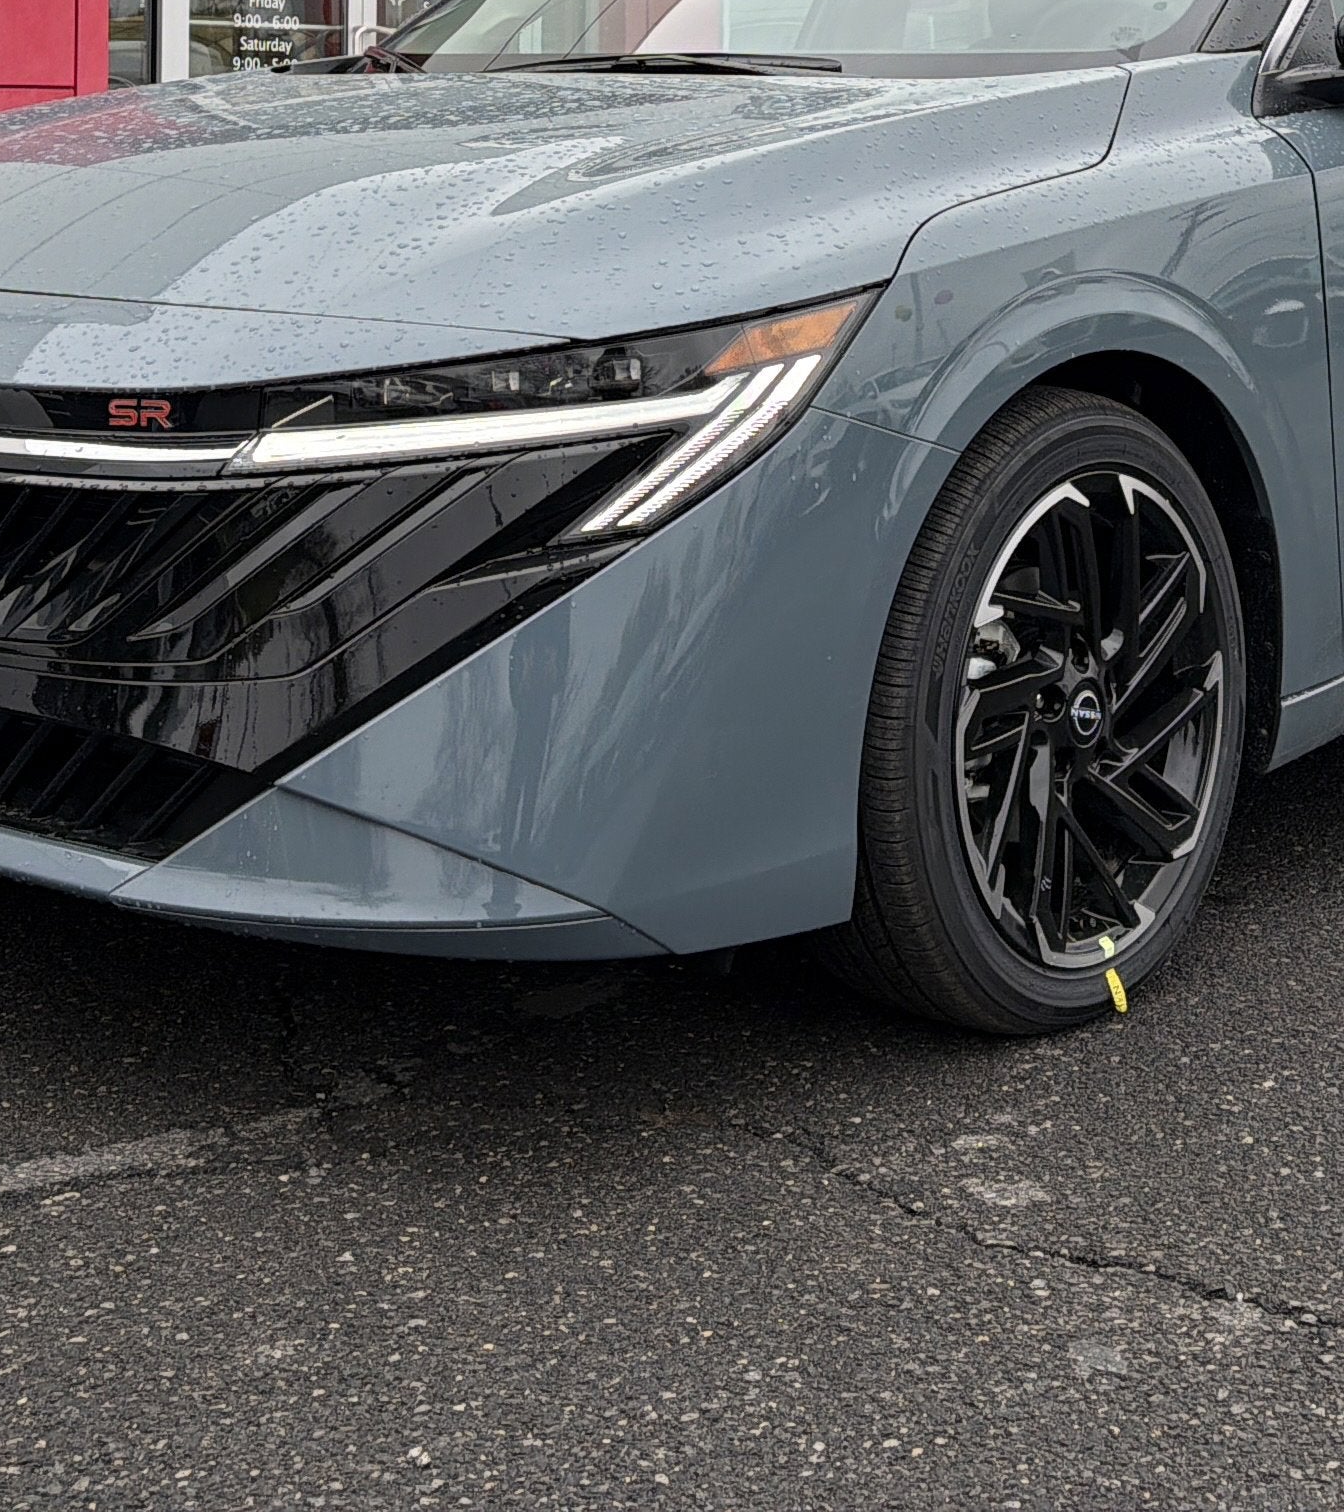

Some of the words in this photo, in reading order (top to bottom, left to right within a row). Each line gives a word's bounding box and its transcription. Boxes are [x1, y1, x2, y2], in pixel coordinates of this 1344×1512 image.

[233, 13, 262, 28] 9:00
[272, 15, 300, 30] 6:00
[240, 36, 293, 55] Saturday
[232, 56, 260, 71] 9:00
[108, 398, 173, 428] SR
